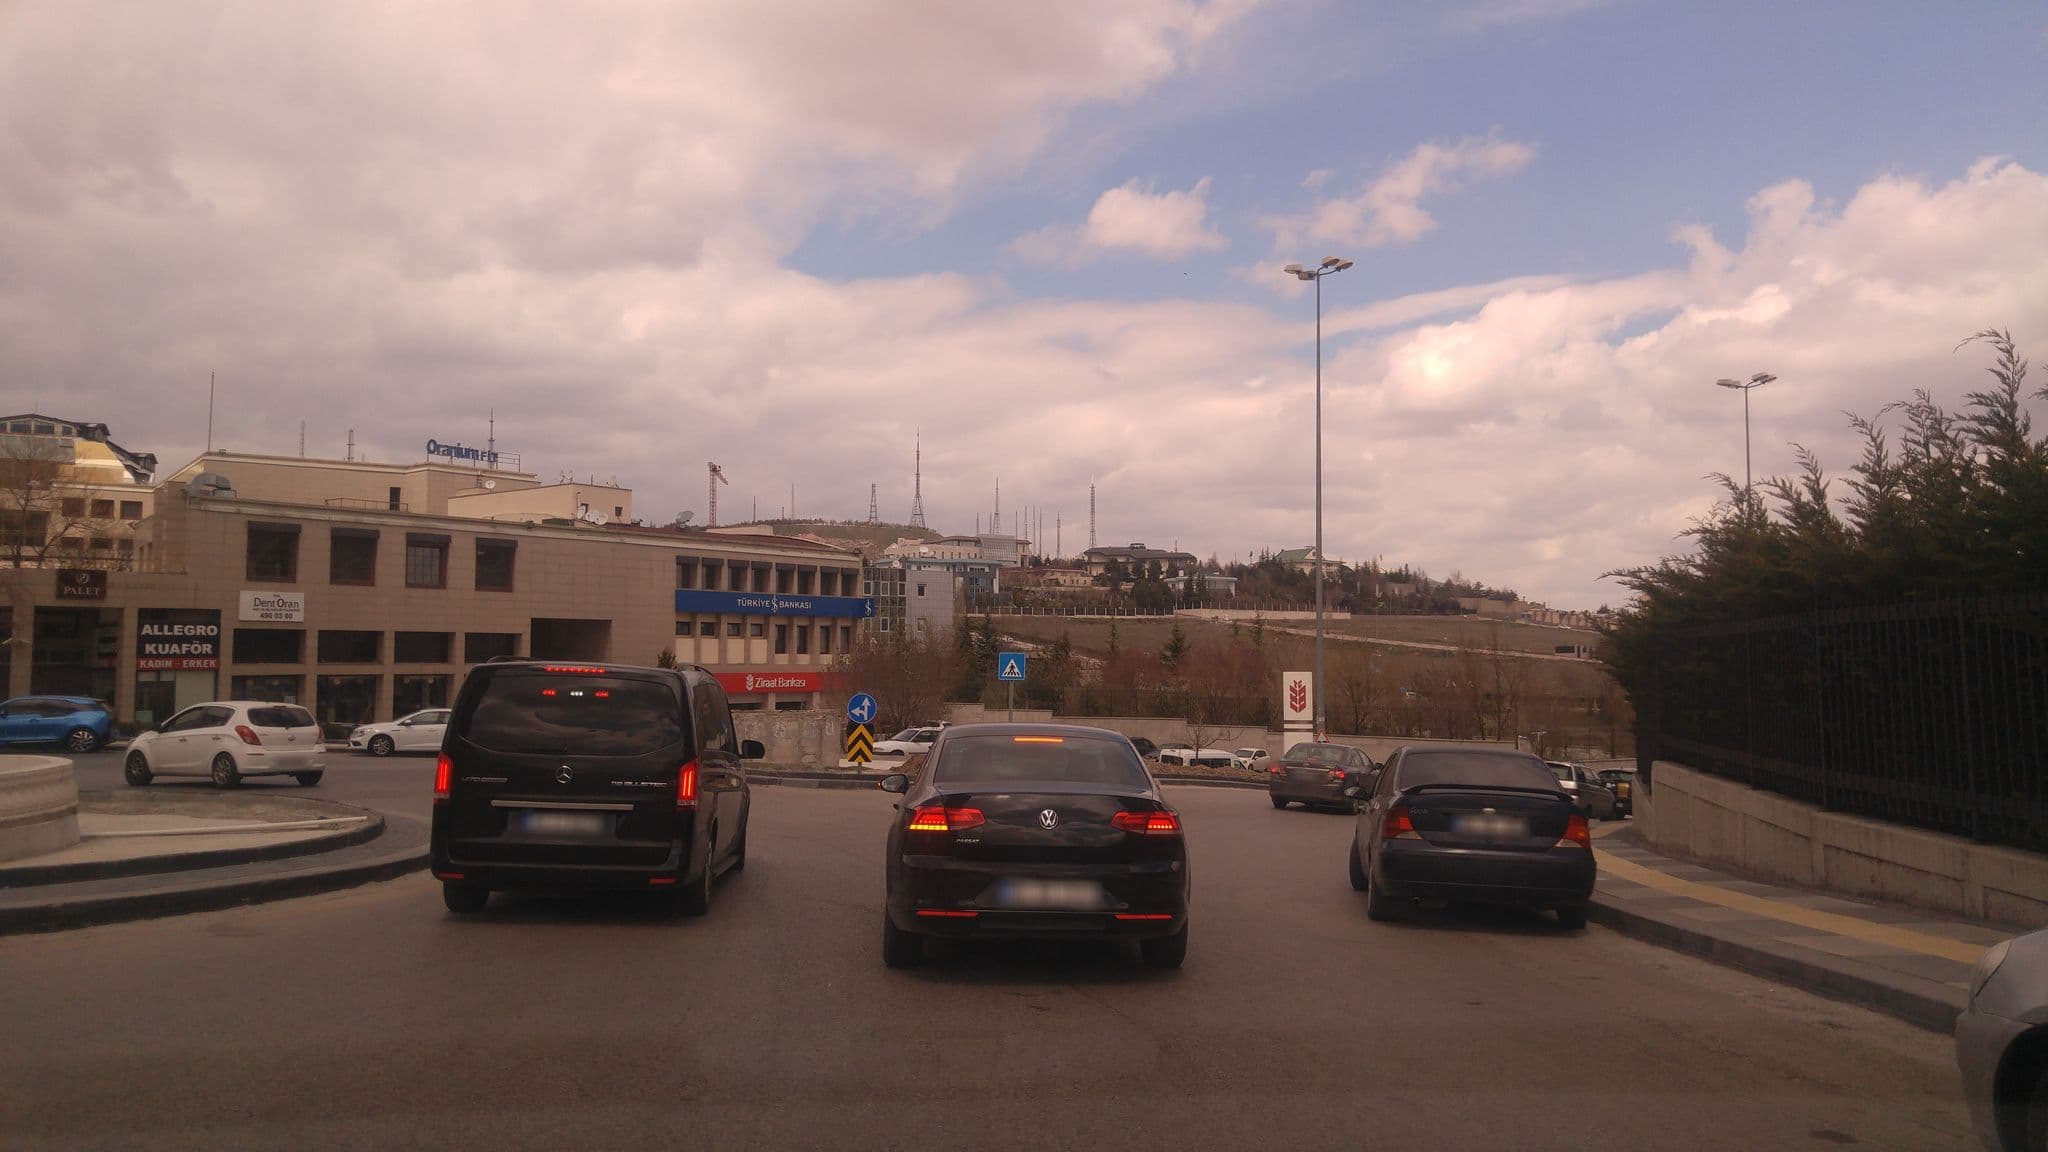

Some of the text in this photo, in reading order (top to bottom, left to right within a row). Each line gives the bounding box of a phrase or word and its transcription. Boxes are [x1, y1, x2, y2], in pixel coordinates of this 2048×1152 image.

[63, 585, 101, 596] PALET
[736, 597, 771, 608] TÜRKİYE
[779, 600, 812, 610] BANKASI
[140, 623, 219, 637] ALLEGRO
[143, 639, 213, 655] KUAFÖR
[139, 658, 172, 669] KADIN
[182, 658, 217, 669] ERKEK
[754, 676, 777, 688] Ziraat
